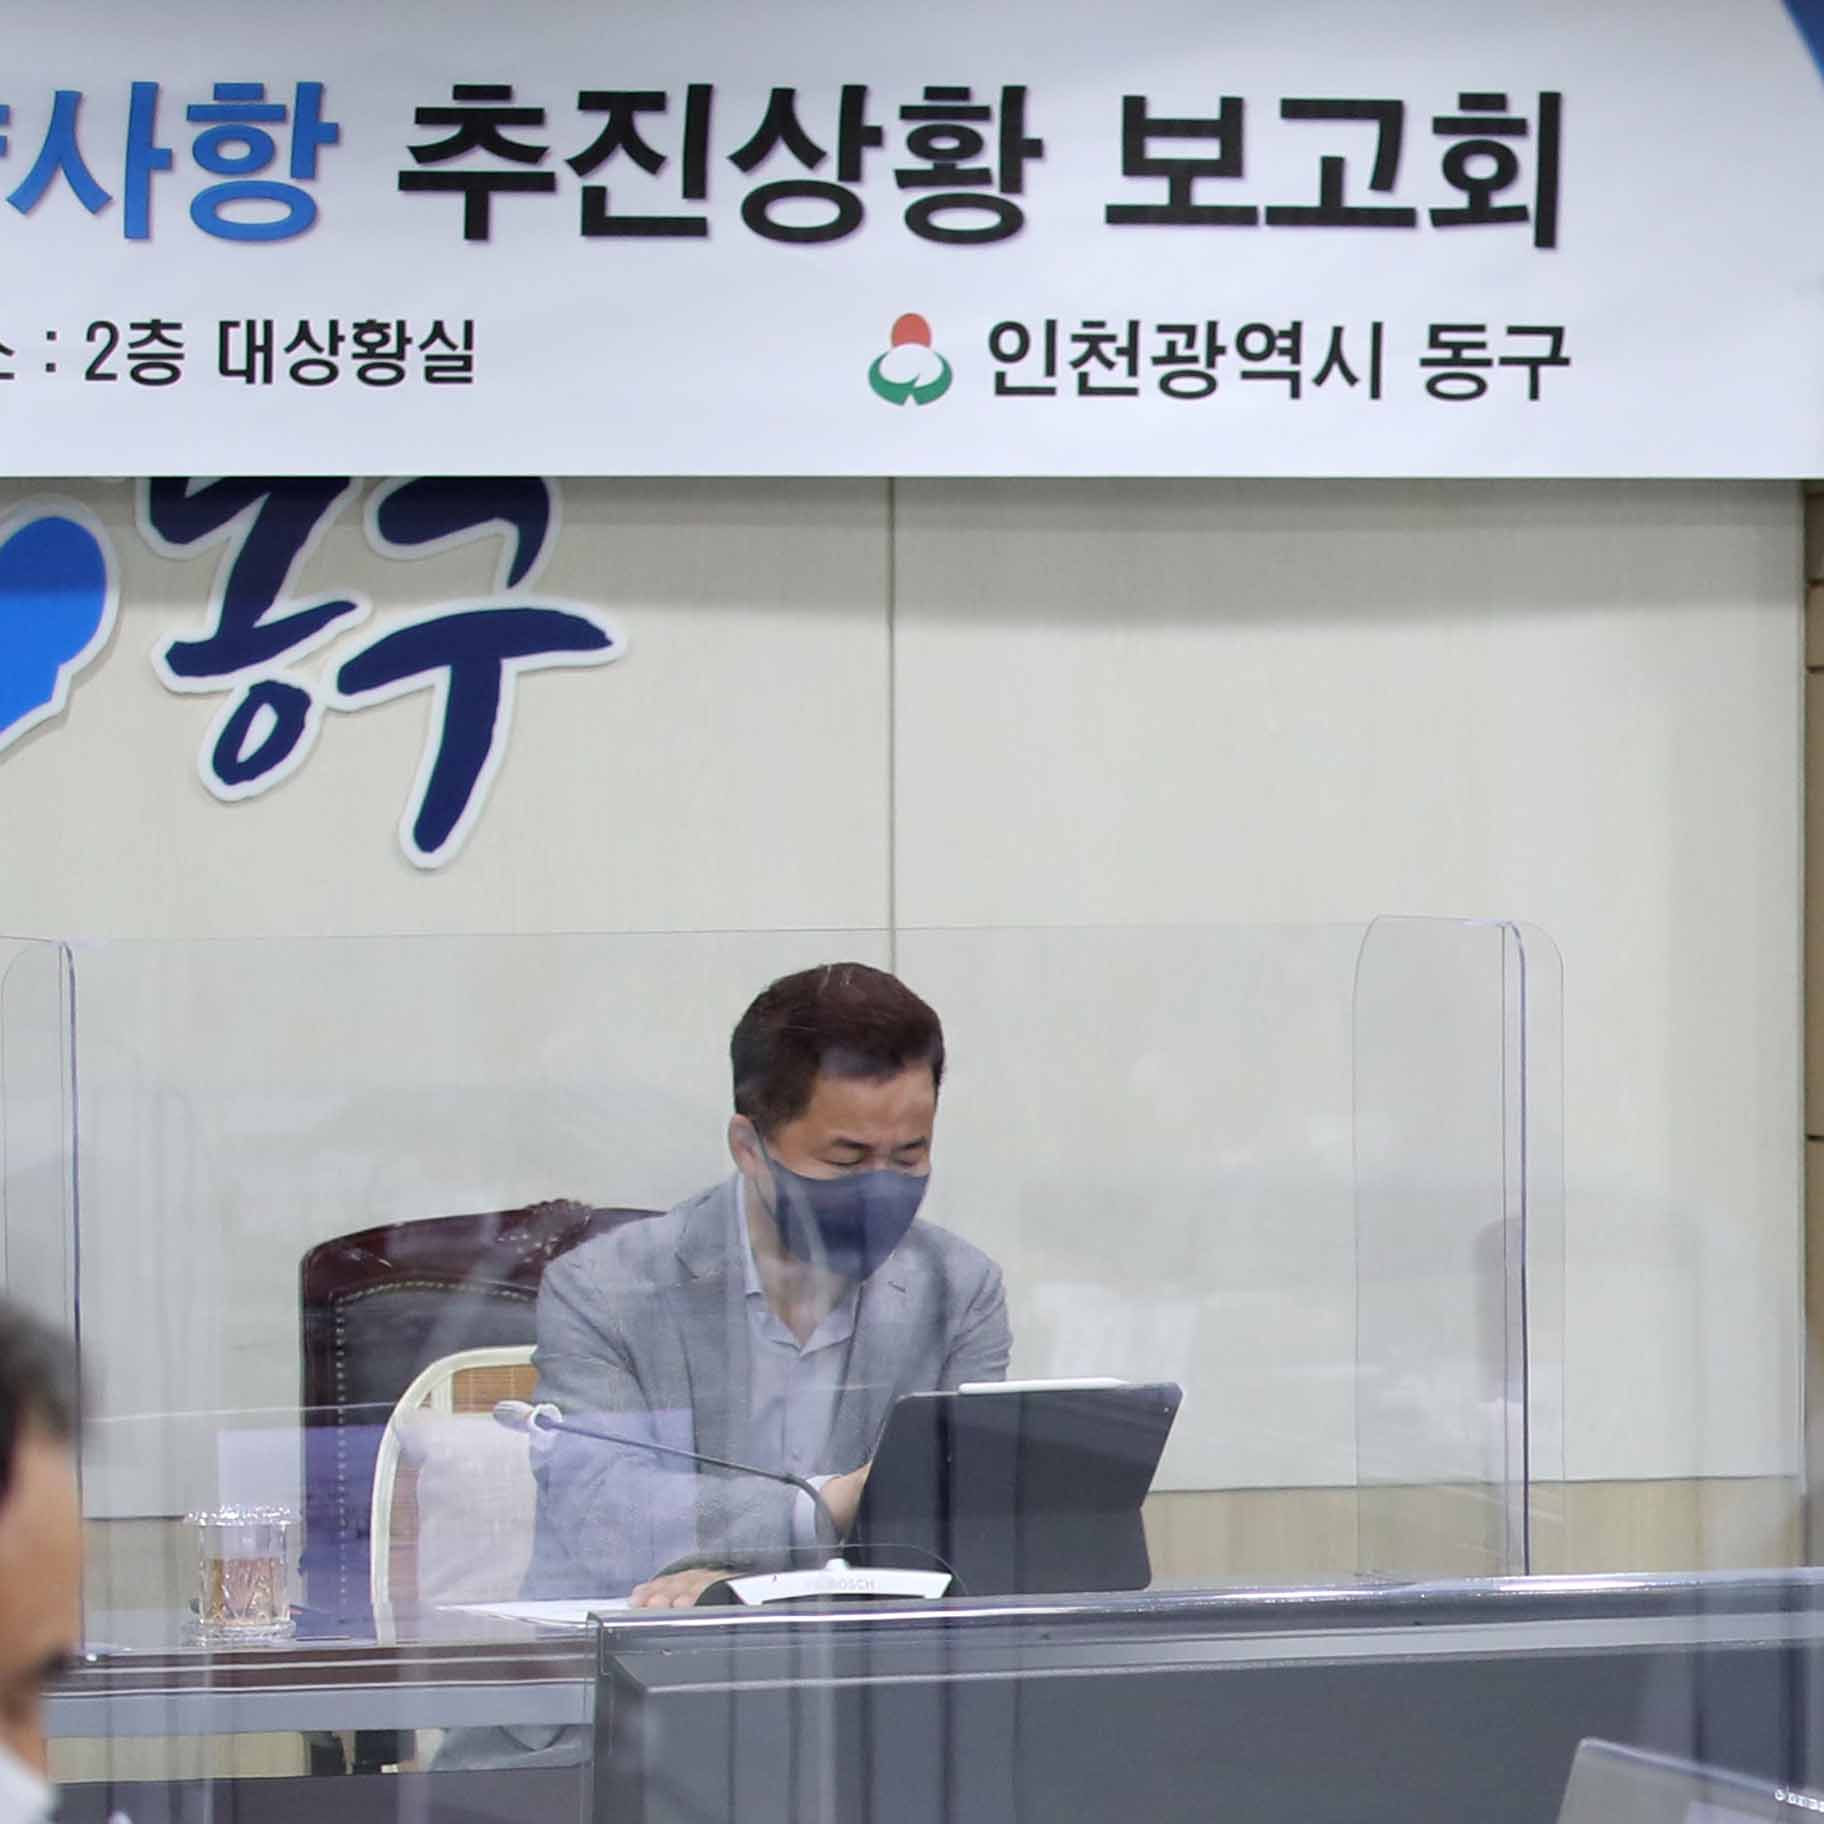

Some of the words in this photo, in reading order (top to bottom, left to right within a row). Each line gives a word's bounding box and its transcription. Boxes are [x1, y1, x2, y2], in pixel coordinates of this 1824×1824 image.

[0, 81, 342, 244] 사항
[397, 83, 1045, 245] 추진상황
[1105, 91, 1563, 249] 보고회
[84, 319, 185, 386] 2층
[217, 319, 475, 386] 대상황실
[989, 319, 1383, 400] 인천광역시
[1420, 324, 1572, 401] 동구
